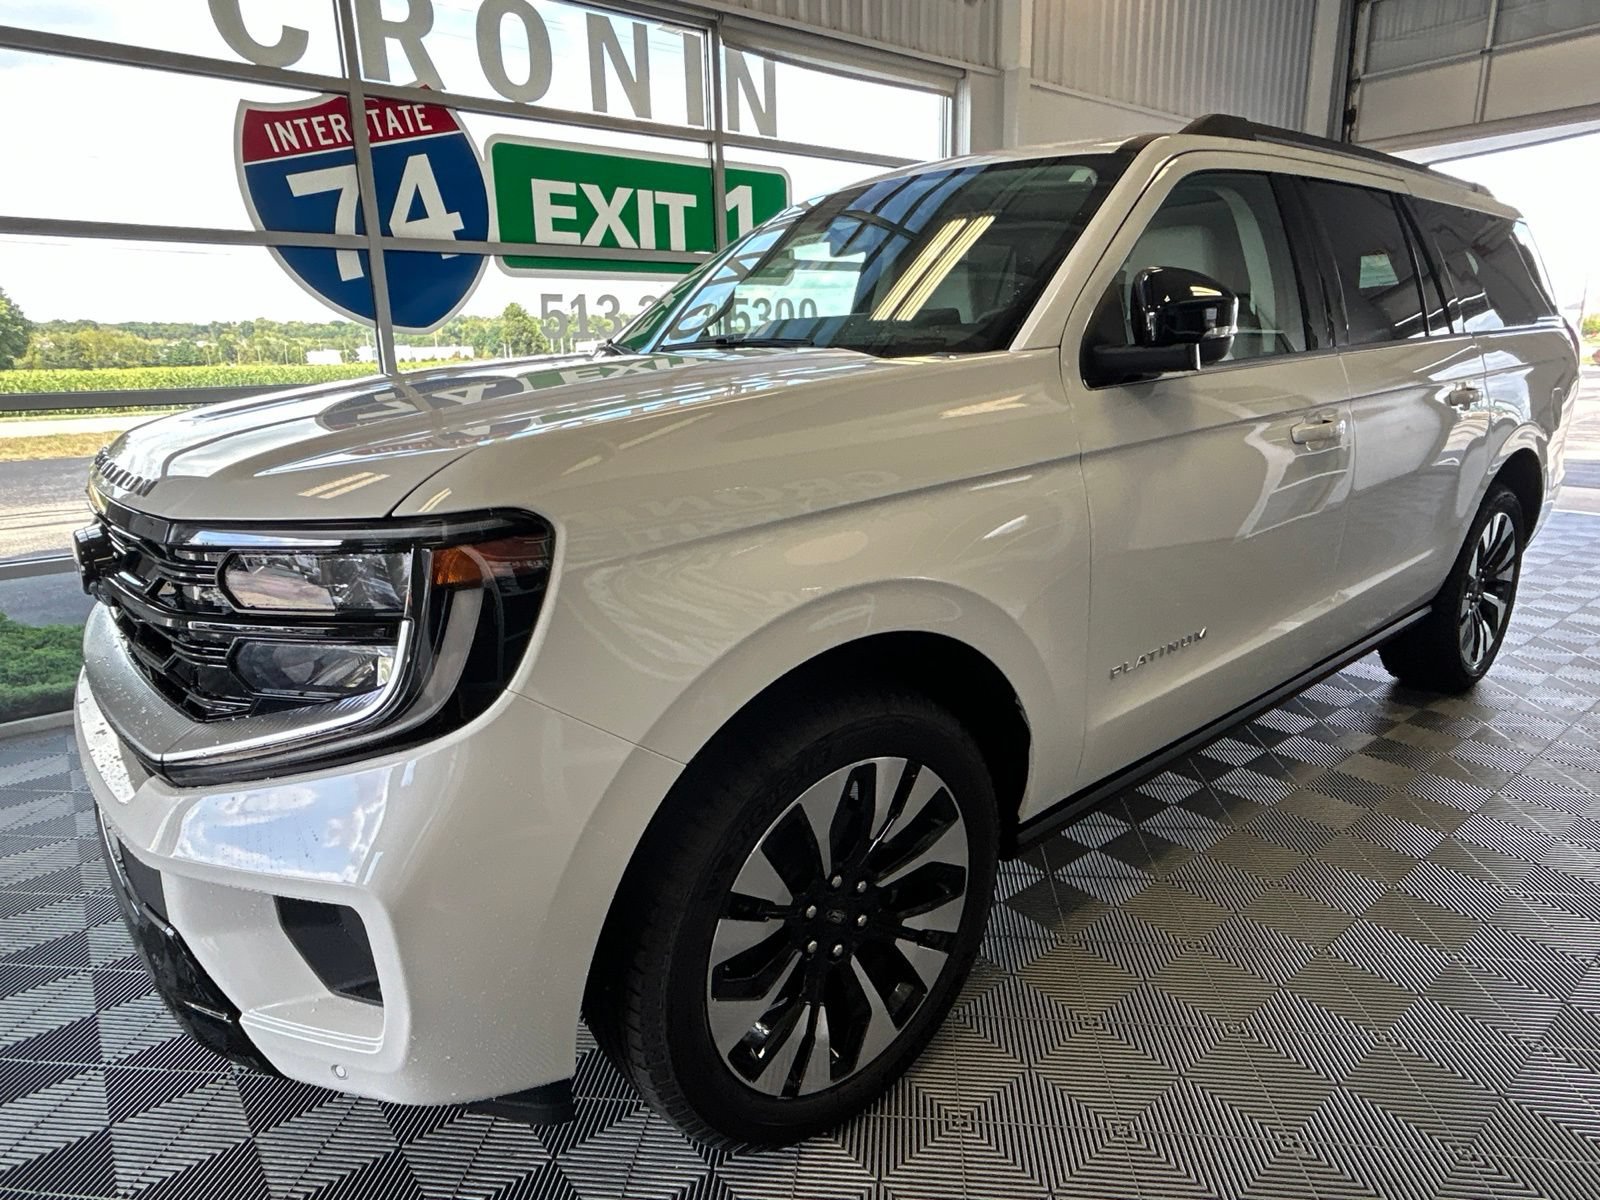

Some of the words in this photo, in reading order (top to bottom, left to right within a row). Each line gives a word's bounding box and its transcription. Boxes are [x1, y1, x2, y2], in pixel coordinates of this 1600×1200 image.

[207, 0, 777, 137] CRONIN
[264, 104, 433, 152] INTERTATE
[285, 153, 465, 282] 74
[531, 178, 697, 251] EXIT
[725, 185, 754, 242] 1
[1109, 626, 1207, 680] PLATINUM
